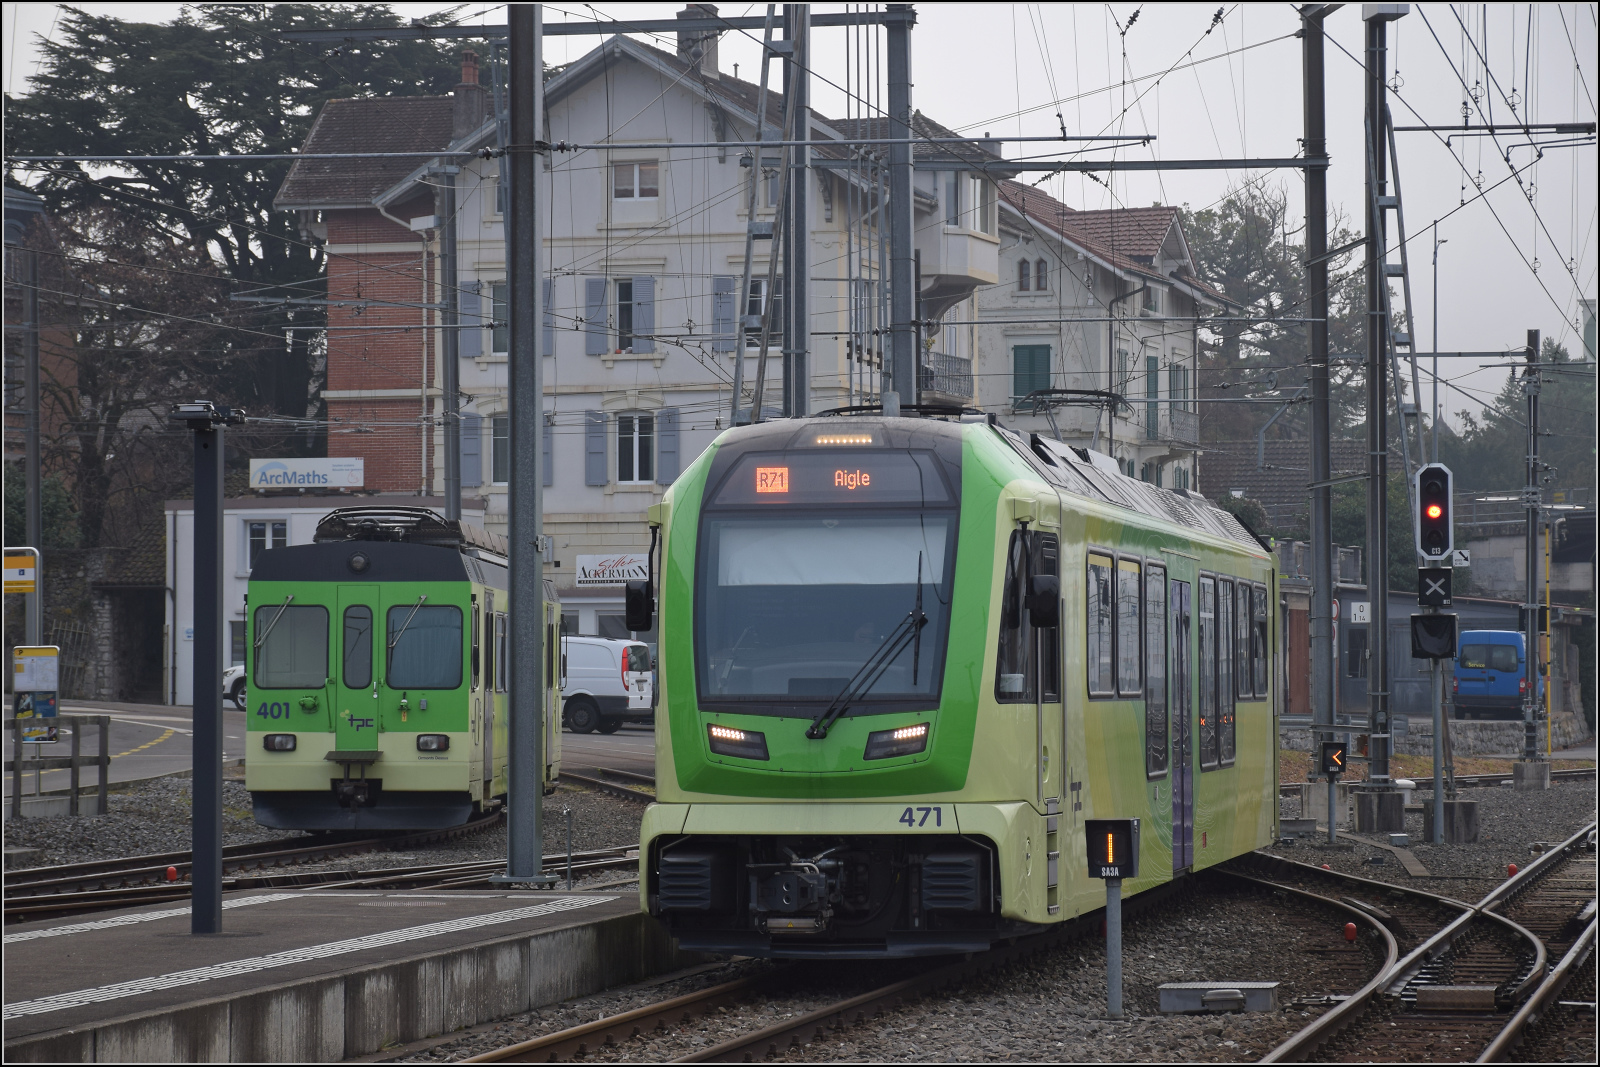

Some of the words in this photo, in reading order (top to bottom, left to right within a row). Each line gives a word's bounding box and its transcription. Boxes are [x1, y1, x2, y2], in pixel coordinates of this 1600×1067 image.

[258, 470, 328, 484] ArcMaths
[760, 472, 784, 488] R71
[834, 469, 870, 490] Aigle
[1431, 547, 1441, 555] C13
[256, 702, 290, 719] 401
[347, 713, 374, 732] tpc
[898, 806, 942, 828] 471
[1101, 866, 1119, 877] SA3A
